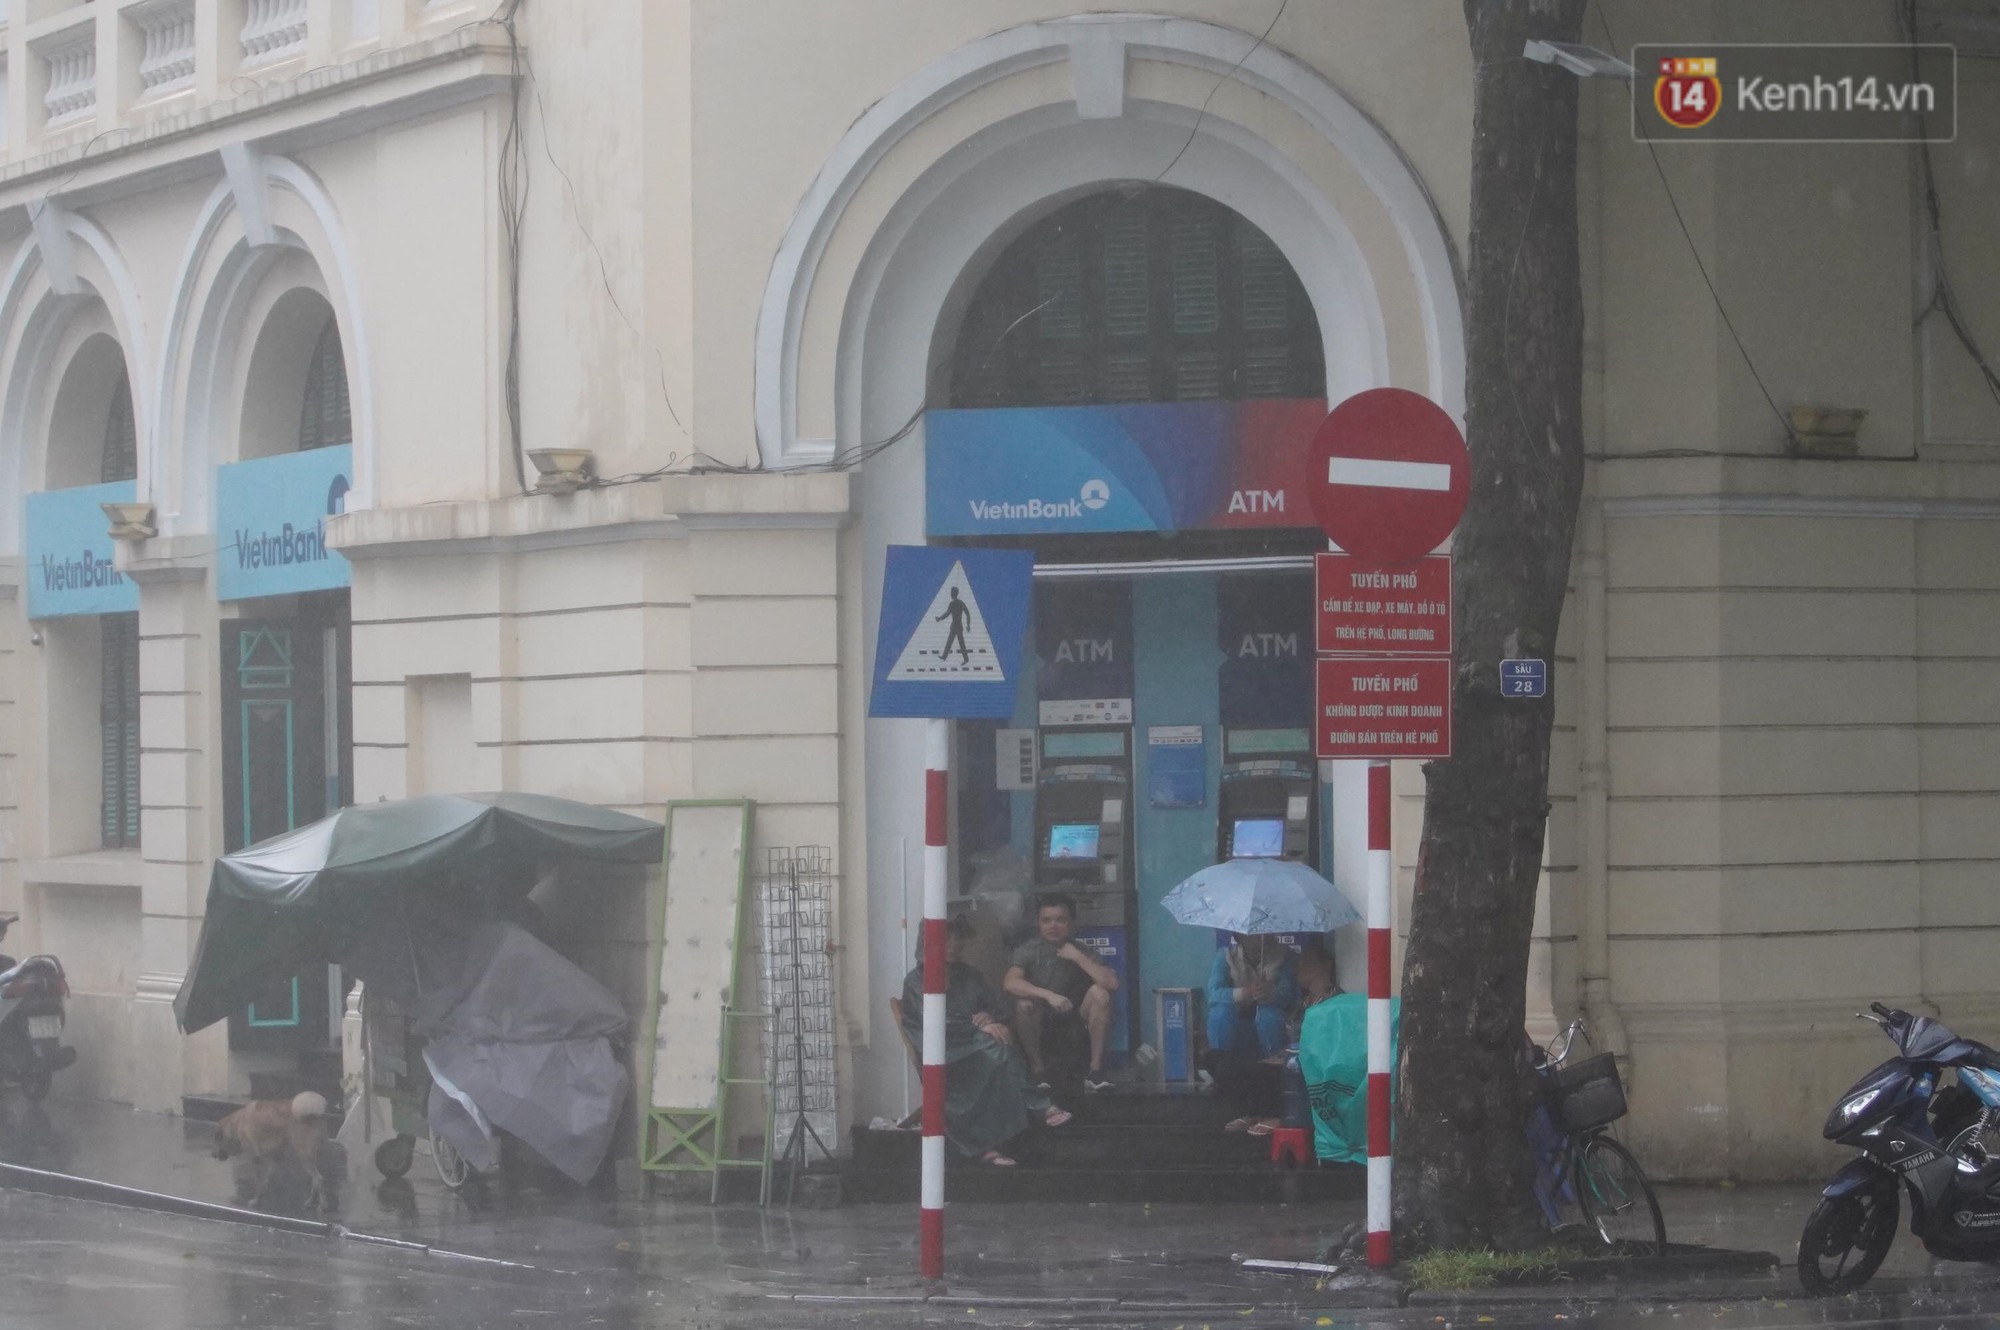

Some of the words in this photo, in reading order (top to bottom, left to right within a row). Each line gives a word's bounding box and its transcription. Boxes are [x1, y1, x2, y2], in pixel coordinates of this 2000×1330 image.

[969, 498, 1082, 520] VietinBank
[1227, 489, 1285, 514] ATM
[235, 518, 328, 569] VietinBank
[1351, 569, 1389, 588] TUYẾN
[1393, 569, 1417, 589] PHỐ
[1355, 601, 1365, 613] XE
[1386, 602, 1395, 614] XE
[1336, 625, 1355, 639] TRÊN
[1055, 638, 1113, 663] ATM
[1238, 632, 1297, 657] ATM
[1352, 673, 1390, 691] TUYẾN
[1394, 673, 1419, 691] PHỐ
[1514, 681, 1533, 692] 28
[1326, 702, 1357, 717] KHÔNG
[1359, 704, 1384, 719] ĐƯỢC
[1387, 705, 1409, 717] KINH
[1358, 729, 1377, 744] BÁN
[1380, 729, 1403, 744] TRÊN
[1420, 728, 1439, 744] PHỐ
[1902, 1151, 1935, 1169] YAMAHA
